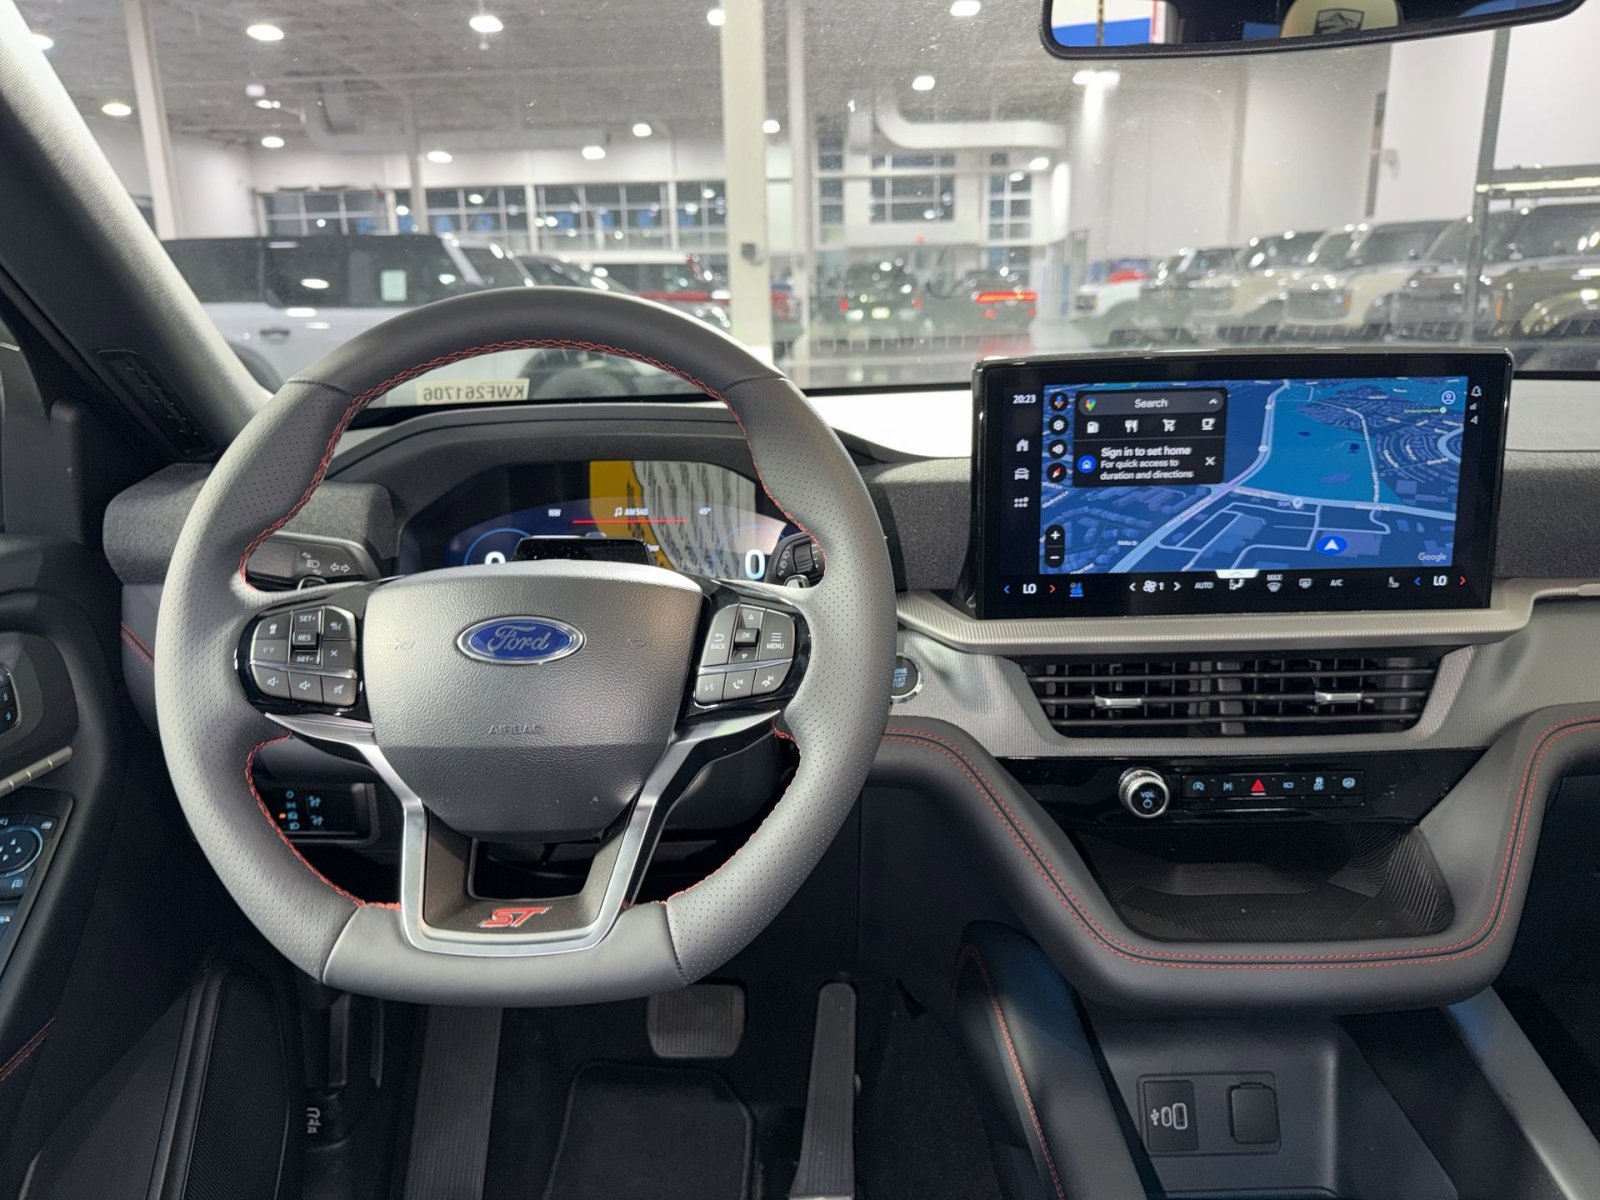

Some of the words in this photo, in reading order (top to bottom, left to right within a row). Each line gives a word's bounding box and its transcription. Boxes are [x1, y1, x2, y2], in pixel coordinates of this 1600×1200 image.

[1012, 394, 1037, 405] 20:23
[1134, 398, 1168, 409] Search
[1100, 447, 1122, 459] Sign
[1124, 447, 1132, 456] in
[1134, 447, 1145, 456] to
[1146, 447, 1162, 456] set
[1164, 446, 1192, 456] home
[1100, 460, 1114, 469] For
[1115, 459, 1137, 470] quick
[1138, 459, 1167, 468] access
[1169, 458, 1179, 467] to
[1100, 470, 1134, 480] duration
[1135, 470, 1151, 479] and
[1152, 469, 1194, 479] directions
[624, 508, 636, 516] AM
[1418, 552, 1447, 562] Google
[745, 549, 766, 580] 0
[1266, 574, 1282, 582] MAX
[1330, 579, 1344, 587] A/C
[1433, 575, 1448, 587] LO
[1022, 583, 1037, 594] LO
[1158, 582, 1165, 591] 1
[1194, 581, 1214, 590] AUTO
[487, 624, 552, 650] Ford
[766, 642, 785, 650] MENU
[488, 724, 544, 735] AIRBAG
[1140, 791, 1155, 799] VOL
[477, 906, 552, 928] ST
